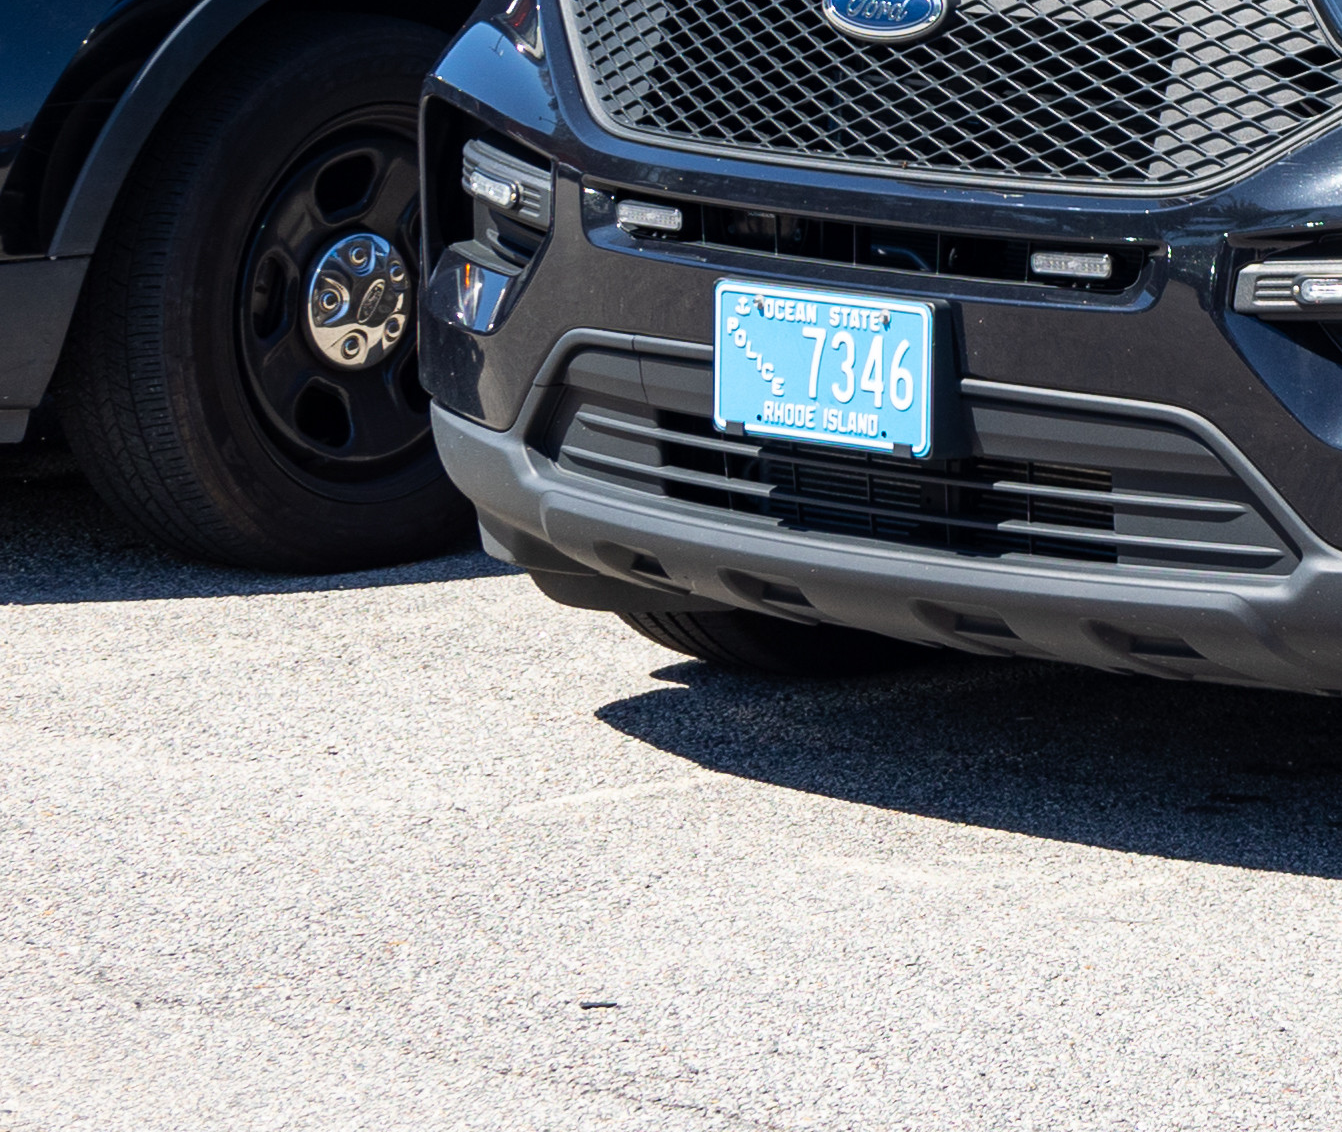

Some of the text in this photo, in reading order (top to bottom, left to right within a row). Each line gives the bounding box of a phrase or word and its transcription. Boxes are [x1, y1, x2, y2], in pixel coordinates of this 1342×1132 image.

[764, 298, 881, 332] OCEAN STATE
[727, 317, 784, 396] POLICE
[802, 327, 914, 411] 7346
[763, 401, 879, 437] RHODE ISLAND
